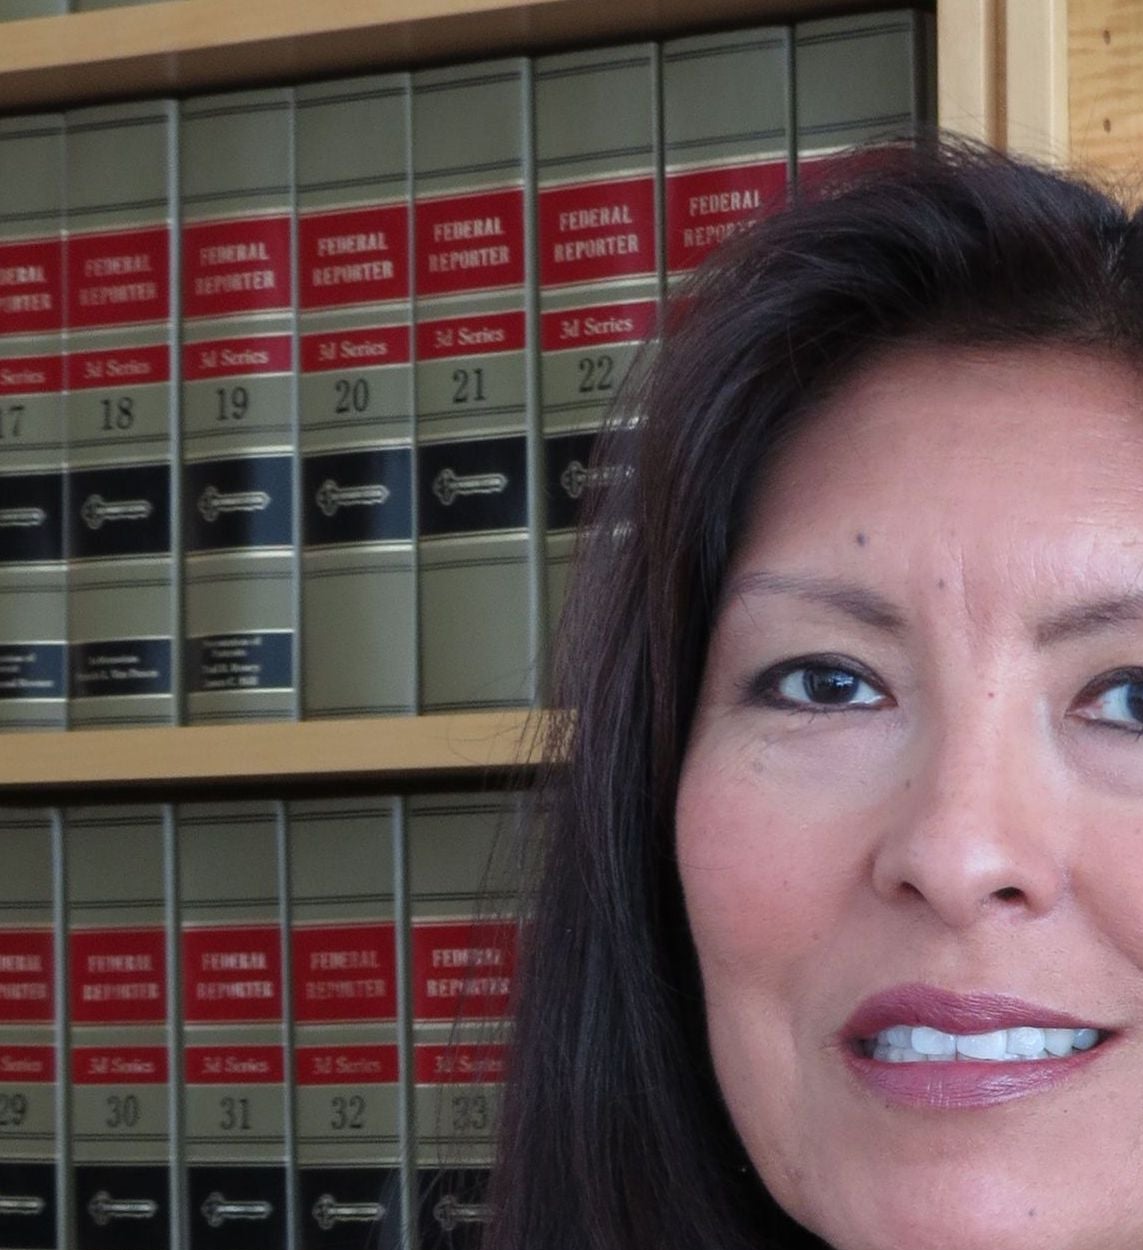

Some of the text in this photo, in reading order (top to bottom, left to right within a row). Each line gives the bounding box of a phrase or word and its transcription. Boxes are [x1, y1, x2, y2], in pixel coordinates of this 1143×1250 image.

[434, 216, 504, 242] FEDERAL
[559, 204, 633, 231] FEDERAL
[318, 231, 388, 257] FEDERAL
[429, 245, 509, 273] REPORTER
[554, 233, 639, 263] REPORTER
[313, 261, 394, 288] REPORTER
[435, 324, 505, 348] 3d Series
[560, 315, 634, 339] 3d Series
[319, 340, 388, 362] 3d Series
[453, 367, 486, 404] 21
[578, 354, 615, 392] 22
[216, 386, 249, 422] 19
[335, 377, 370, 414] 20
[101, 396, 135, 431] 18
[106, 1095, 139, 1128] 30
[220, 1097, 253, 1130] 31
[331, 1096, 366, 1129] 32
